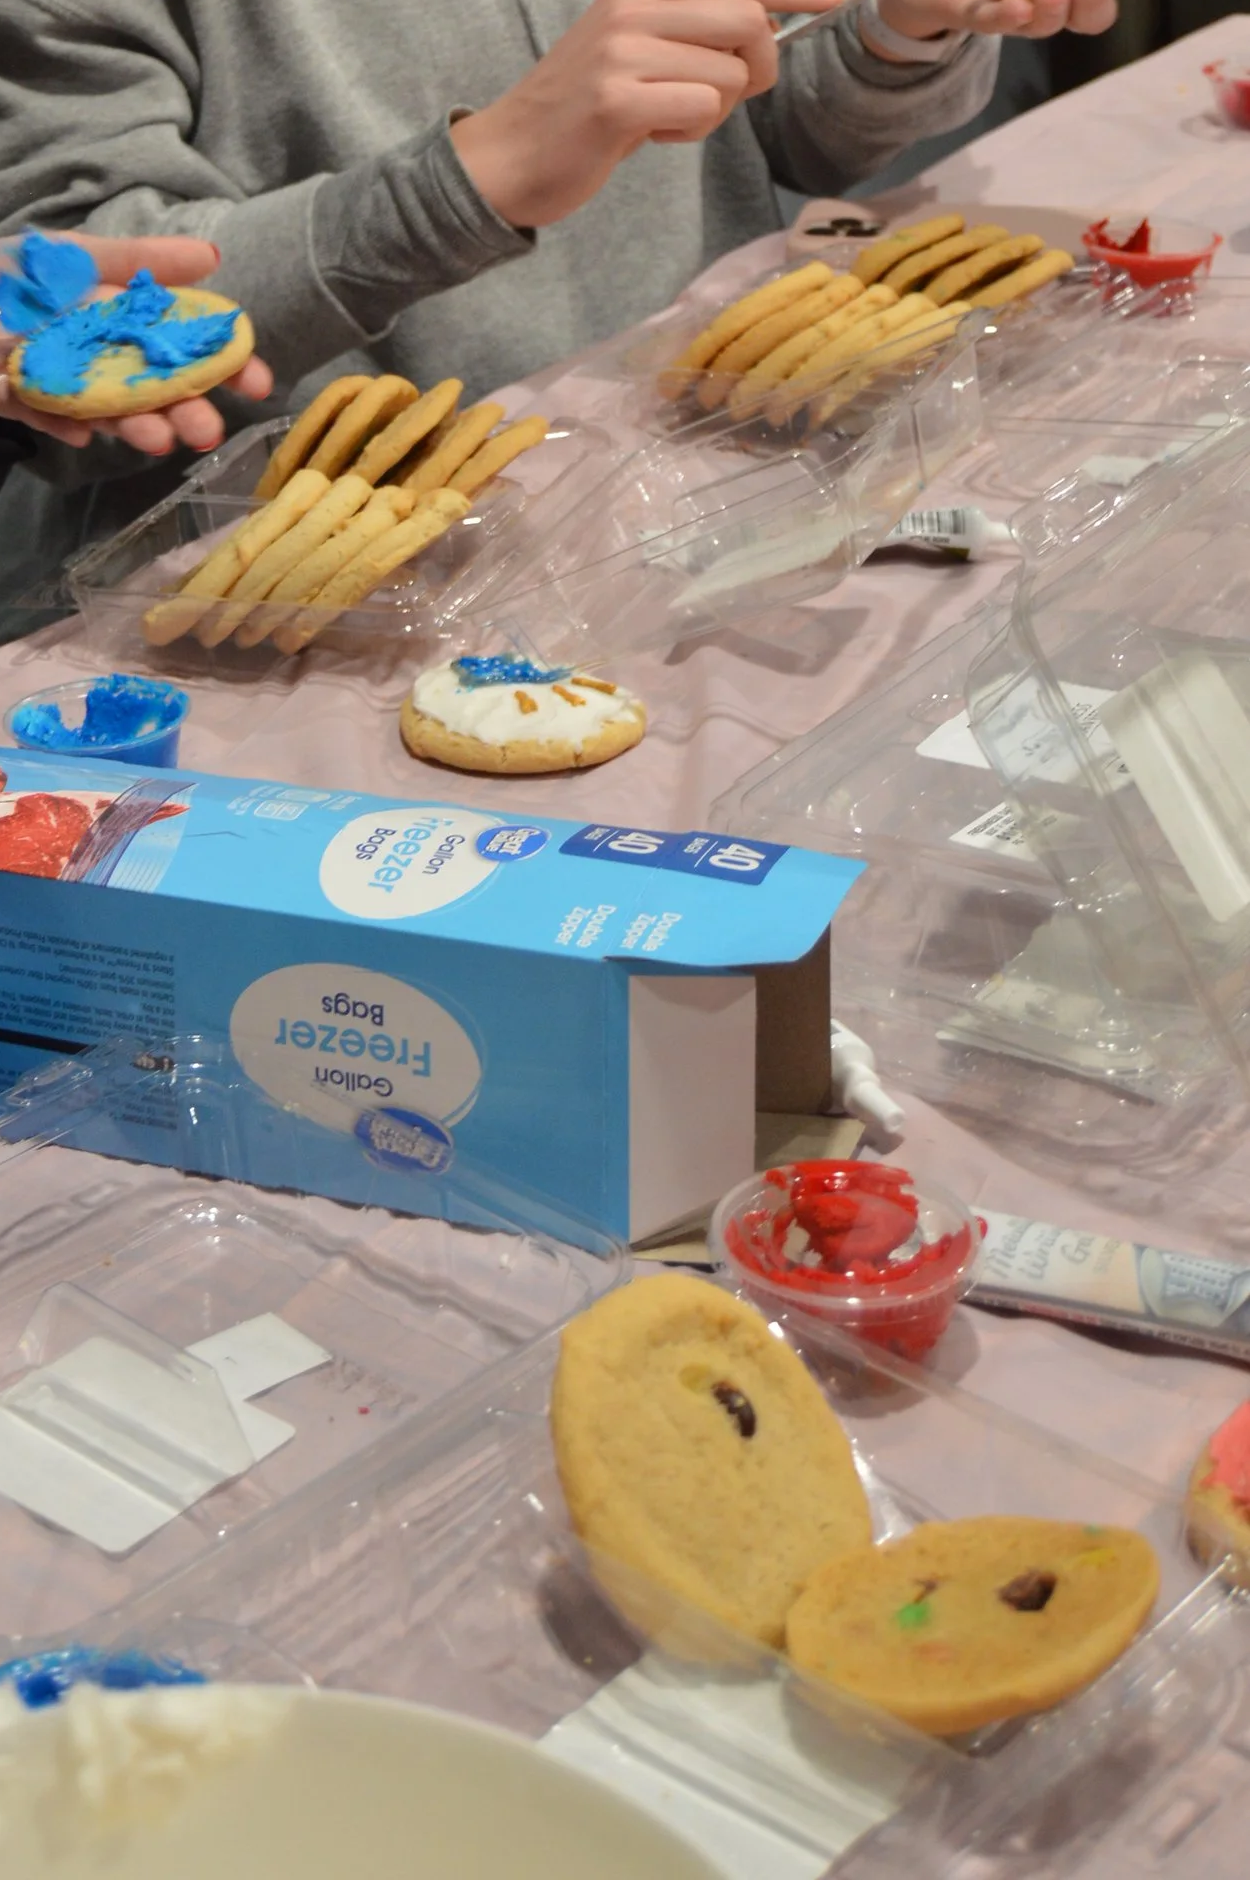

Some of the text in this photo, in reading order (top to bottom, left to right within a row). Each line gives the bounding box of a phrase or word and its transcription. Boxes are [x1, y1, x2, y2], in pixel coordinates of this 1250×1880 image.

[356, 827, 397, 861] Bags
[422, 834, 465, 875] Gallon
[499, 828, 540, 855] Great
[608, 832, 665, 855] 40
[683, 837, 710, 854] BAGS
[709, 843, 766, 871] 40
[555, 906, 592, 946] Zipper
[576, 904, 617, 948] Double
[620, 913, 658, 949] Zipper
[642, 912, 682, 951] Double
[321, 993, 384, 1026] Bags
[274, 1018, 431, 1077] Freezer
[315, 1066, 393, 1097] Gallon
